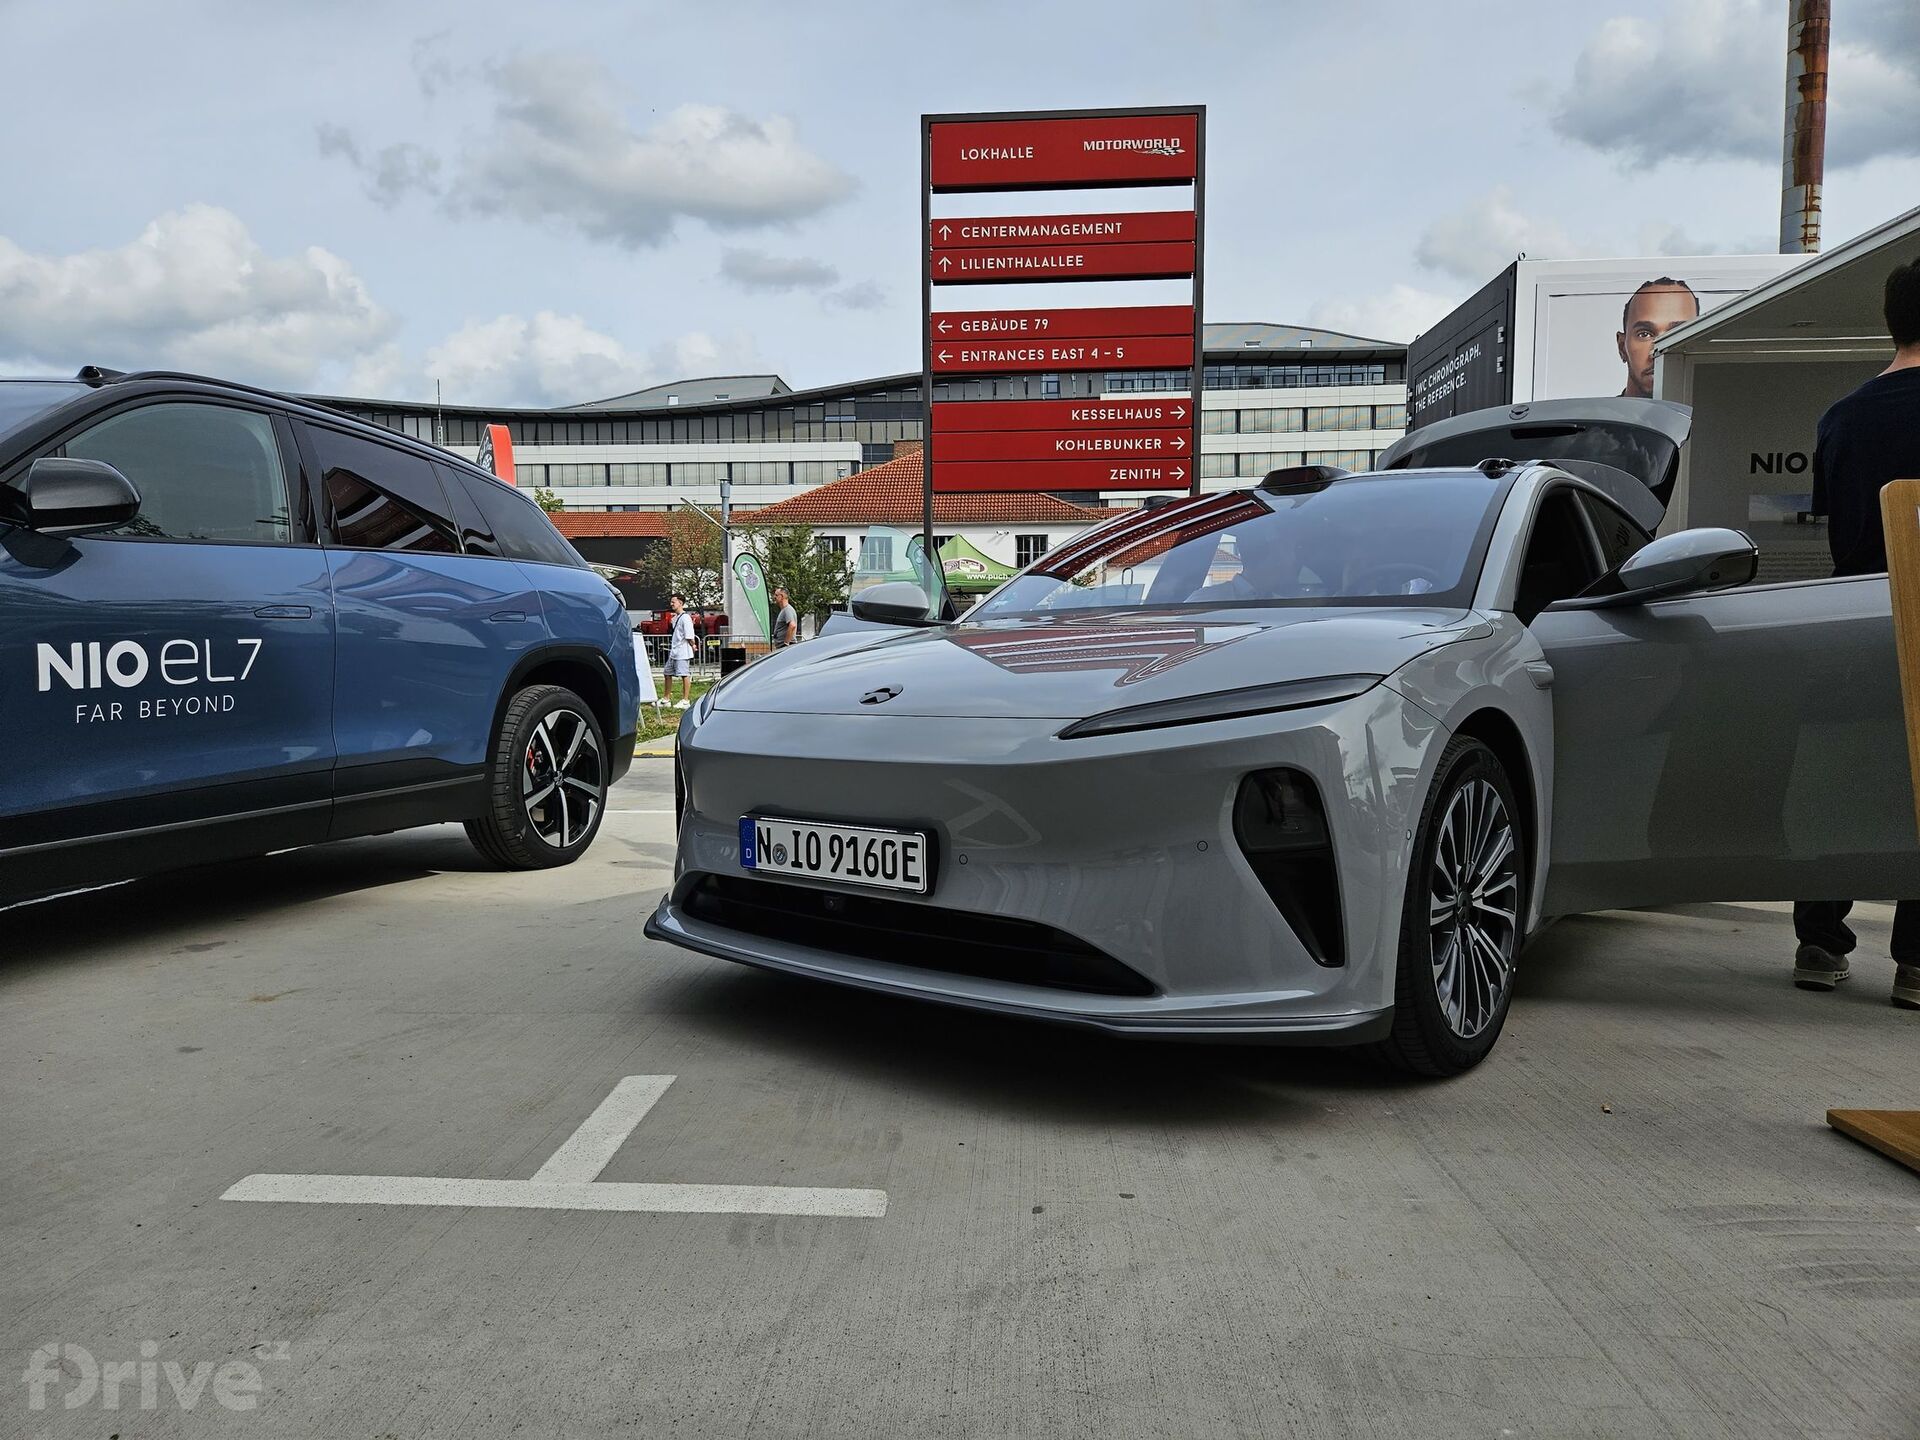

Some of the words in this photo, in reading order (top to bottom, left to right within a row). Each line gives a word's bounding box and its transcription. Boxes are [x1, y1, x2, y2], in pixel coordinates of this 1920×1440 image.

[1083, 138, 1180, 151] MOTORWORLD
[961, 147, 1034, 160] LOKHALLE
[961, 223, 1122, 238] CENTERMANAGEMENT
[961, 256, 1084, 270] LILIENTHALALLEE
[961, 318, 1028, 332] GEBÄUDE
[1035, 319, 1049, 330] 79
[961, 349, 1044, 362] ENTRANCES
[1052, 349, 1084, 360] EAST
[1091, 348, 1098, 359] 4
[1117, 348, 1124, 358] 5
[1416, 379, 1427, 396] IWC
[1429, 344, 1481, 387] CHRONOGRAPH.
[1415, 396, 1426, 413] THE
[1428, 373, 1466, 405] REFERENCE.
[1071, 408, 1162, 420] KESSELHAUS
[1056, 438, 1162, 451] KOHLEBUNKER
[1750, 452, 1808, 474] NIO
[1110, 469, 1161, 480] ZENITH
[38, 640, 149, 692] NIO
[75, 702, 123, 724] FAR
[140, 694, 235, 719] BEYOND
[745, 848, 751, 859] D
[757, 826, 771, 864] N
[829, 833, 920, 883] 9160E
